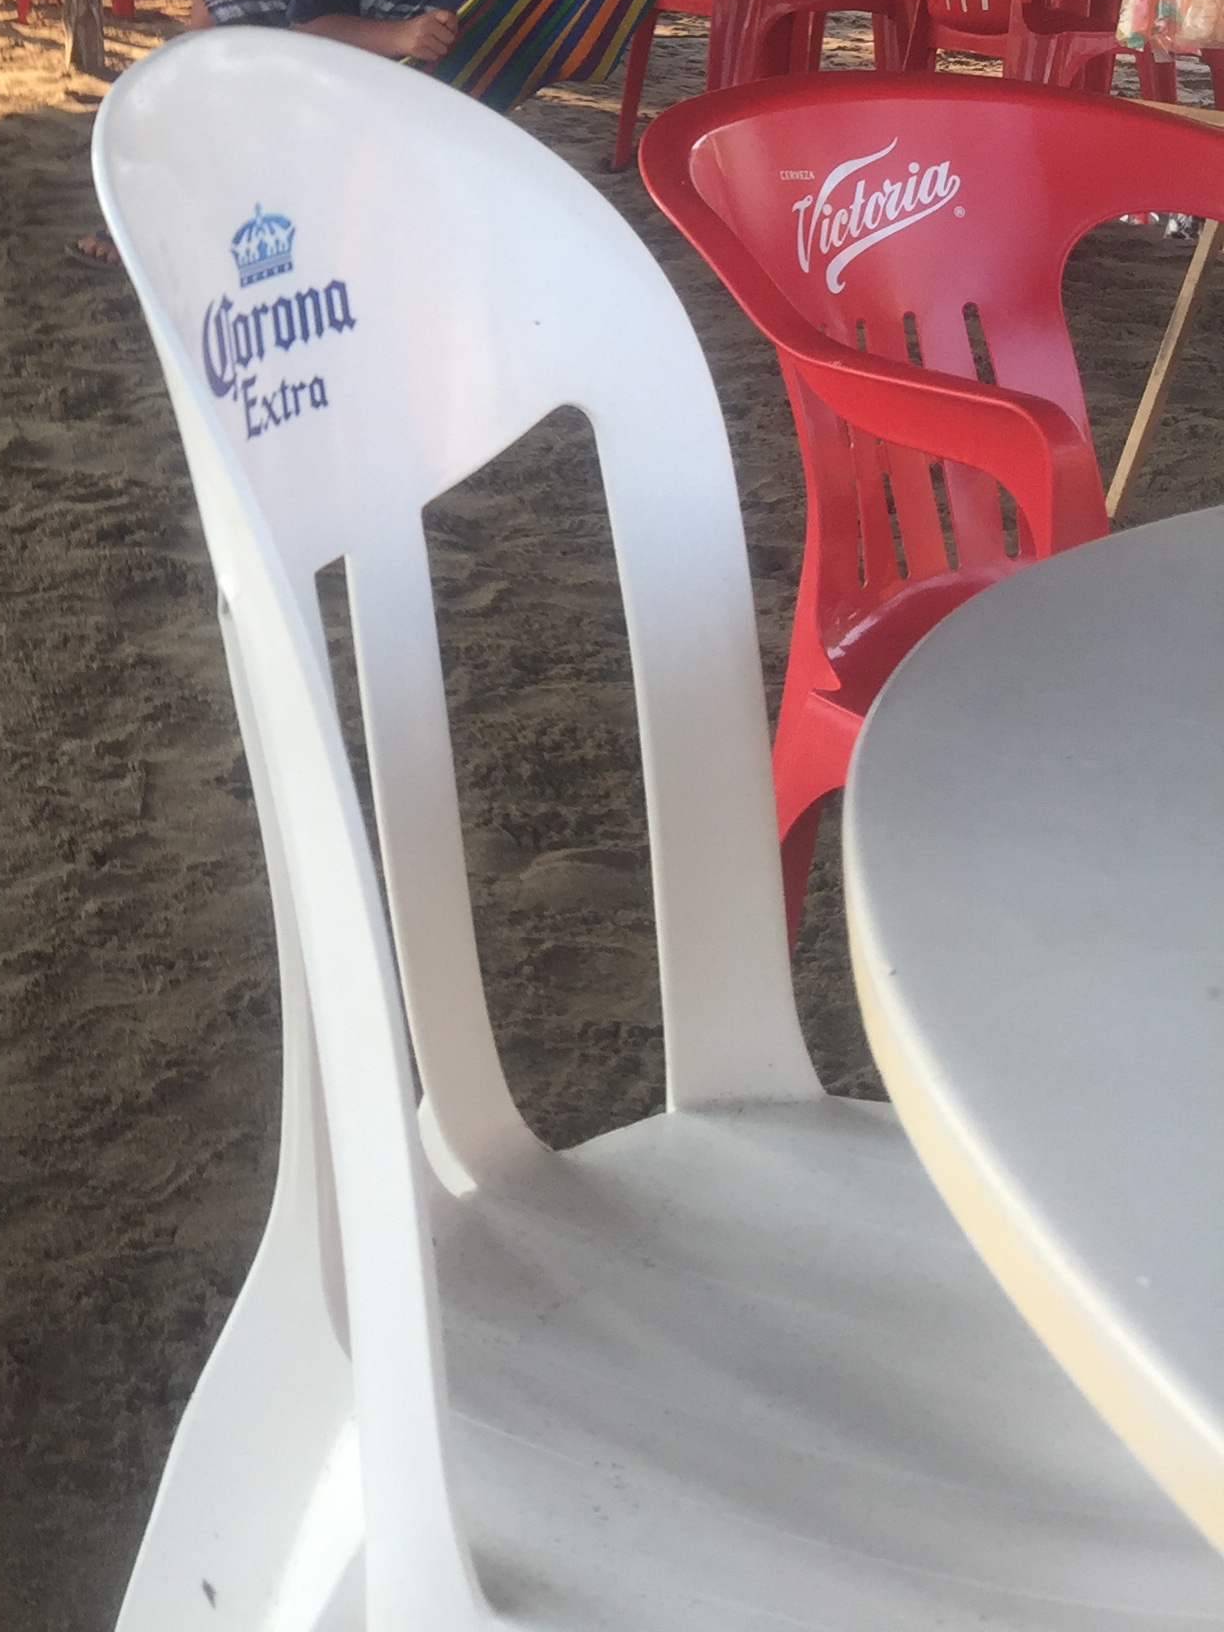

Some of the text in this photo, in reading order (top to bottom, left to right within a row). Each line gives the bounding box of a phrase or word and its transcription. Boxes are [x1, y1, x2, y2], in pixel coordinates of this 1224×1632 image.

[779, 170, 815, 181] CERVEZA
[792, 136, 961, 294] Victoria
[202, 279, 357, 401] Corona
[242, 375, 328, 440] Extra
